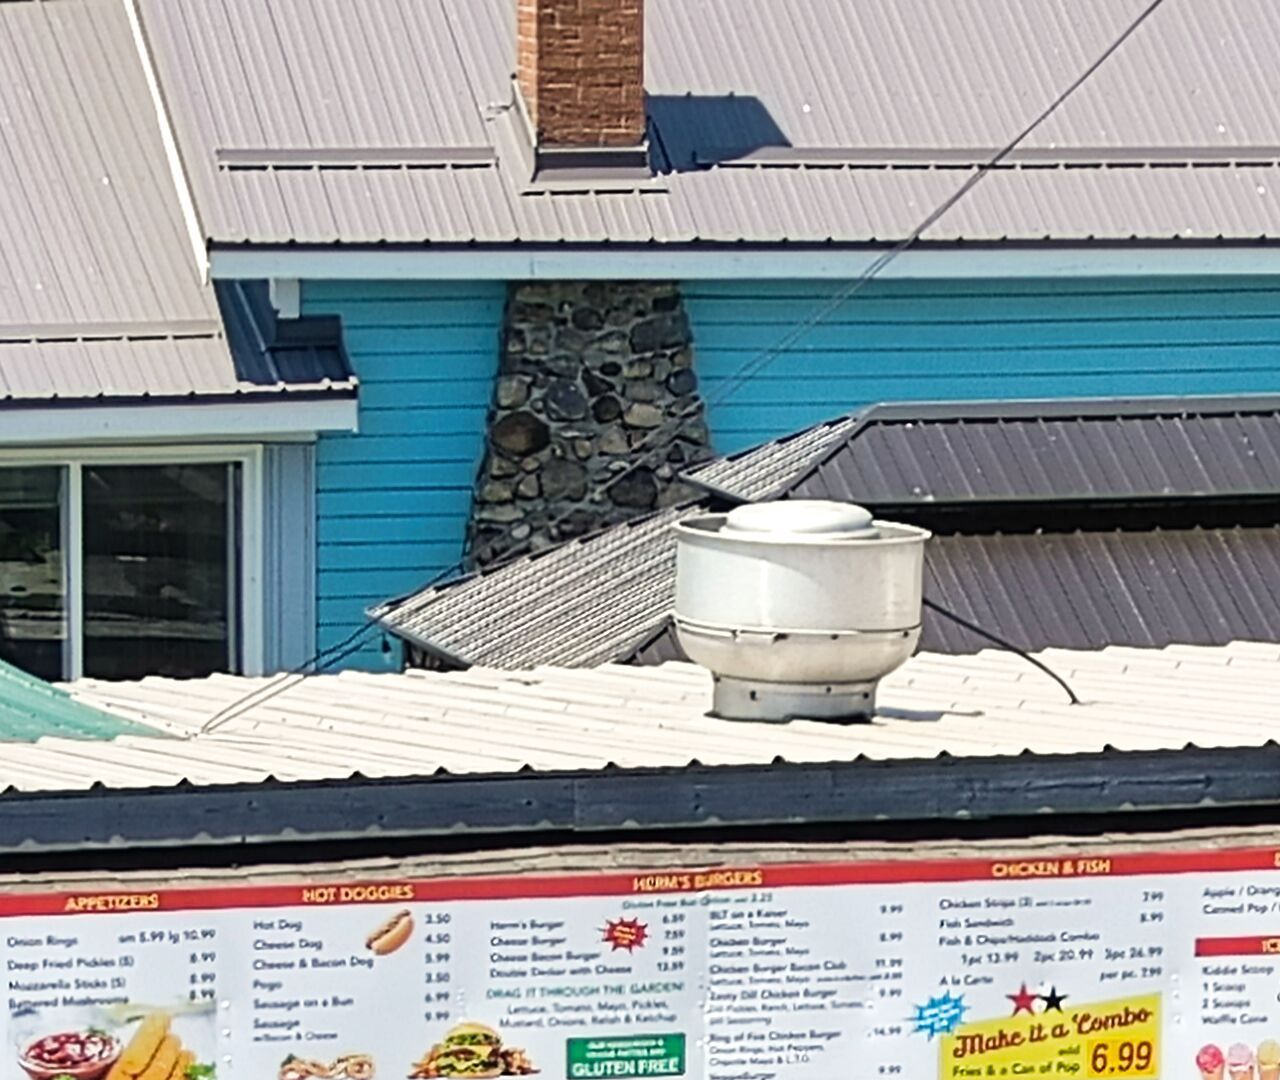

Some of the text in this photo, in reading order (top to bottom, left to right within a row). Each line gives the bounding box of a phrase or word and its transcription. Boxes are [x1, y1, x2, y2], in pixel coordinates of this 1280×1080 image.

[992, 861, 1059, 877] CHICKEN
[1077, 859, 1110, 873] FISH
[694, 871, 762, 887] BURGERS
[302, 885, 414, 902] HOT DOGGIES
[65, 895, 159, 910] APPETIZERS
[953, 1006, 1153, 1057] Make it a Combo
[1091, 1041, 1152, 1073] 6.99
[572, 1057, 679, 1077] GLUTEN FREE
[953, 1066, 981, 1076] Fries
[1012, 1063, 1035, 1074] Can
